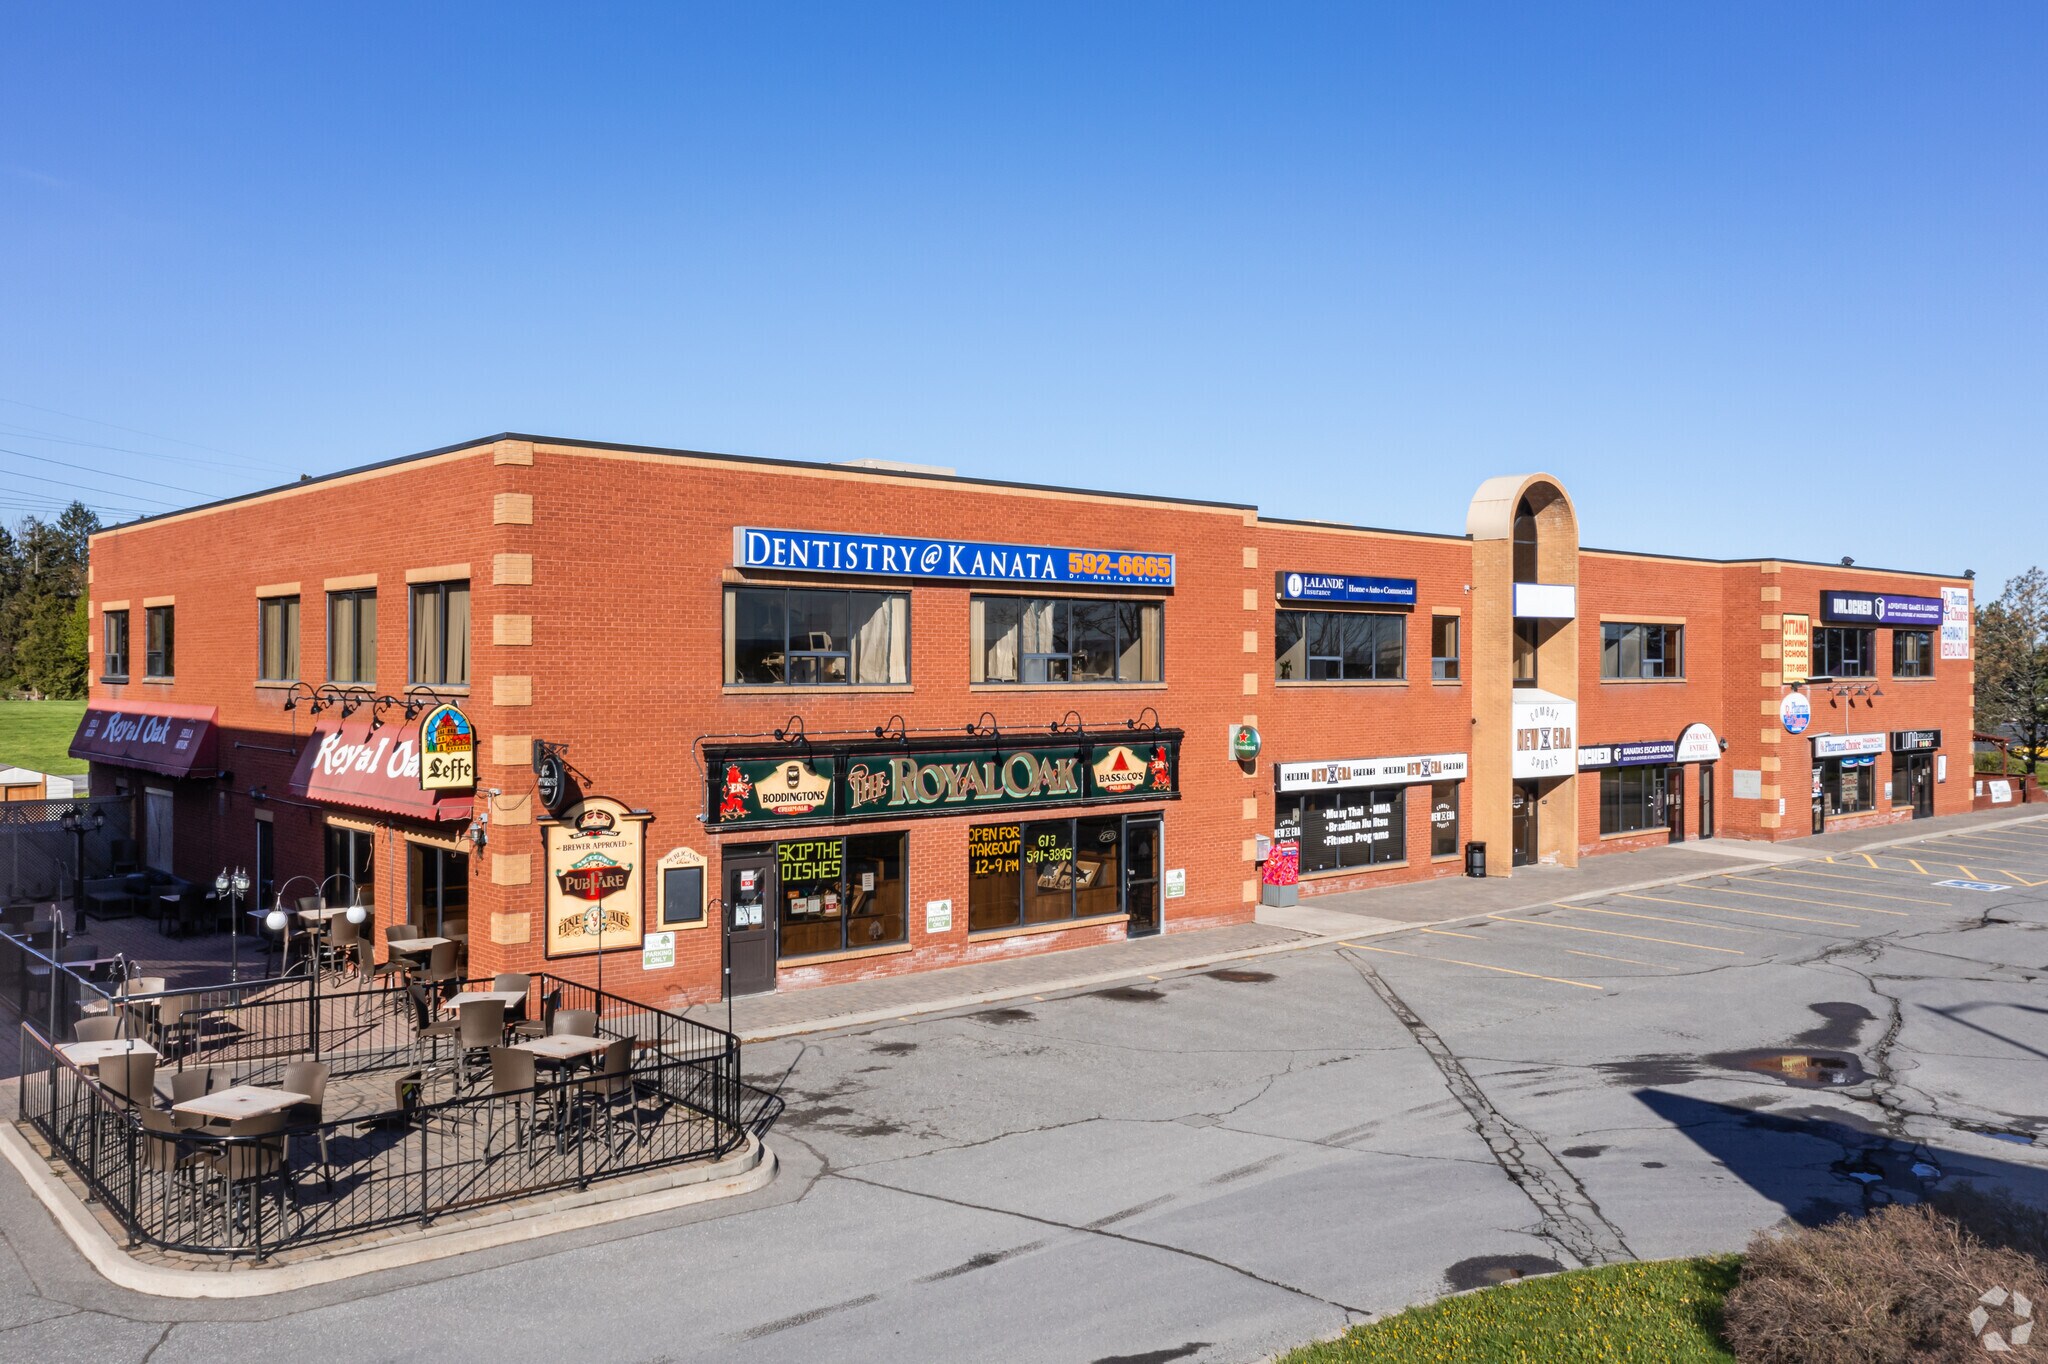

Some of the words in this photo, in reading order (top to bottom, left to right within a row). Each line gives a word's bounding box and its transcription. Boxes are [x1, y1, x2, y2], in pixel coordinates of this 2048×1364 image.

[1068, 552, 1171, 577] 592-6665
[1094, 575, 1131, 583] Ashfaq
[1304, 577, 1345, 589] LALANDE
[1304, 588, 1331, 596] Insurance
[1349, 585, 1366, 593] Home
[1369, 586, 1381, 594] Auto
[1384, 587, 1413, 595] Commercial
[1833, 598, 1873, 615] UNLOCKED
[1784, 619, 1807, 636] OTTAWA
[1784, 640, 1807, 648] DRIVING
[1530, 706, 1559, 722] COMBAT
[101, 712, 147, 743] Royal
[142, 715, 173, 744] Oak
[1517, 728, 1540, 751] NEW
[1552, 727, 1572, 750] ERA
[311, 732, 390, 776] Royal
[386, 739, 421, 778] Oa
[427, 757, 472, 782] Leffe
[1383, 766, 1406, 774] COMBAT
[1407, 762, 1421, 776] NEW
[1430, 761, 1442, 774] ERA
[1444, 762, 1464, 770] SPORTS
[1530, 756, 1558, 770] SPORTS
[848, 764, 889, 808] THE
[888, 757, 1003, 806] ROYAL
[1002, 752, 1079, 798] OAK
[1284, 772, 1310, 781] COMBAT
[1312, 768, 1328, 782] NEW
[1338, 766, 1352, 780] ERA
[1353, 768, 1376, 776] SPORTS
[762, 790, 825, 803] BODDINGTONS
[1348, 806, 1364, 817] Thai
[1372, 804, 1391, 814] MMA
[1431, 812, 1442, 822] NEW
[1446, 810, 1455, 820] ERA
[1291, 826, 1300, 836] ERA
[1328, 820, 1360, 832] Brazilian
[968, 828, 998, 842] OPEN
[999, 826, 1020, 838] FOR
[1038, 834, 1056, 847] 613
[562, 842, 590, 852] BREWER
[592, 841, 627, 850] APPROVED
[778, 842, 814, 862] SKIP
[815, 841, 842, 860] THE
[970, 840, 1020, 858] TAKEOUT
[782, 860, 841, 881] DISHES
[975, 858, 1002, 874] 12-9
[1004, 858, 1020, 872] PM
[558, 914, 582, 936] FINE
[608, 911, 631, 928] ALES
[646, 949, 672, 958] PARKING
[651, 955, 667, 963] ONLY
